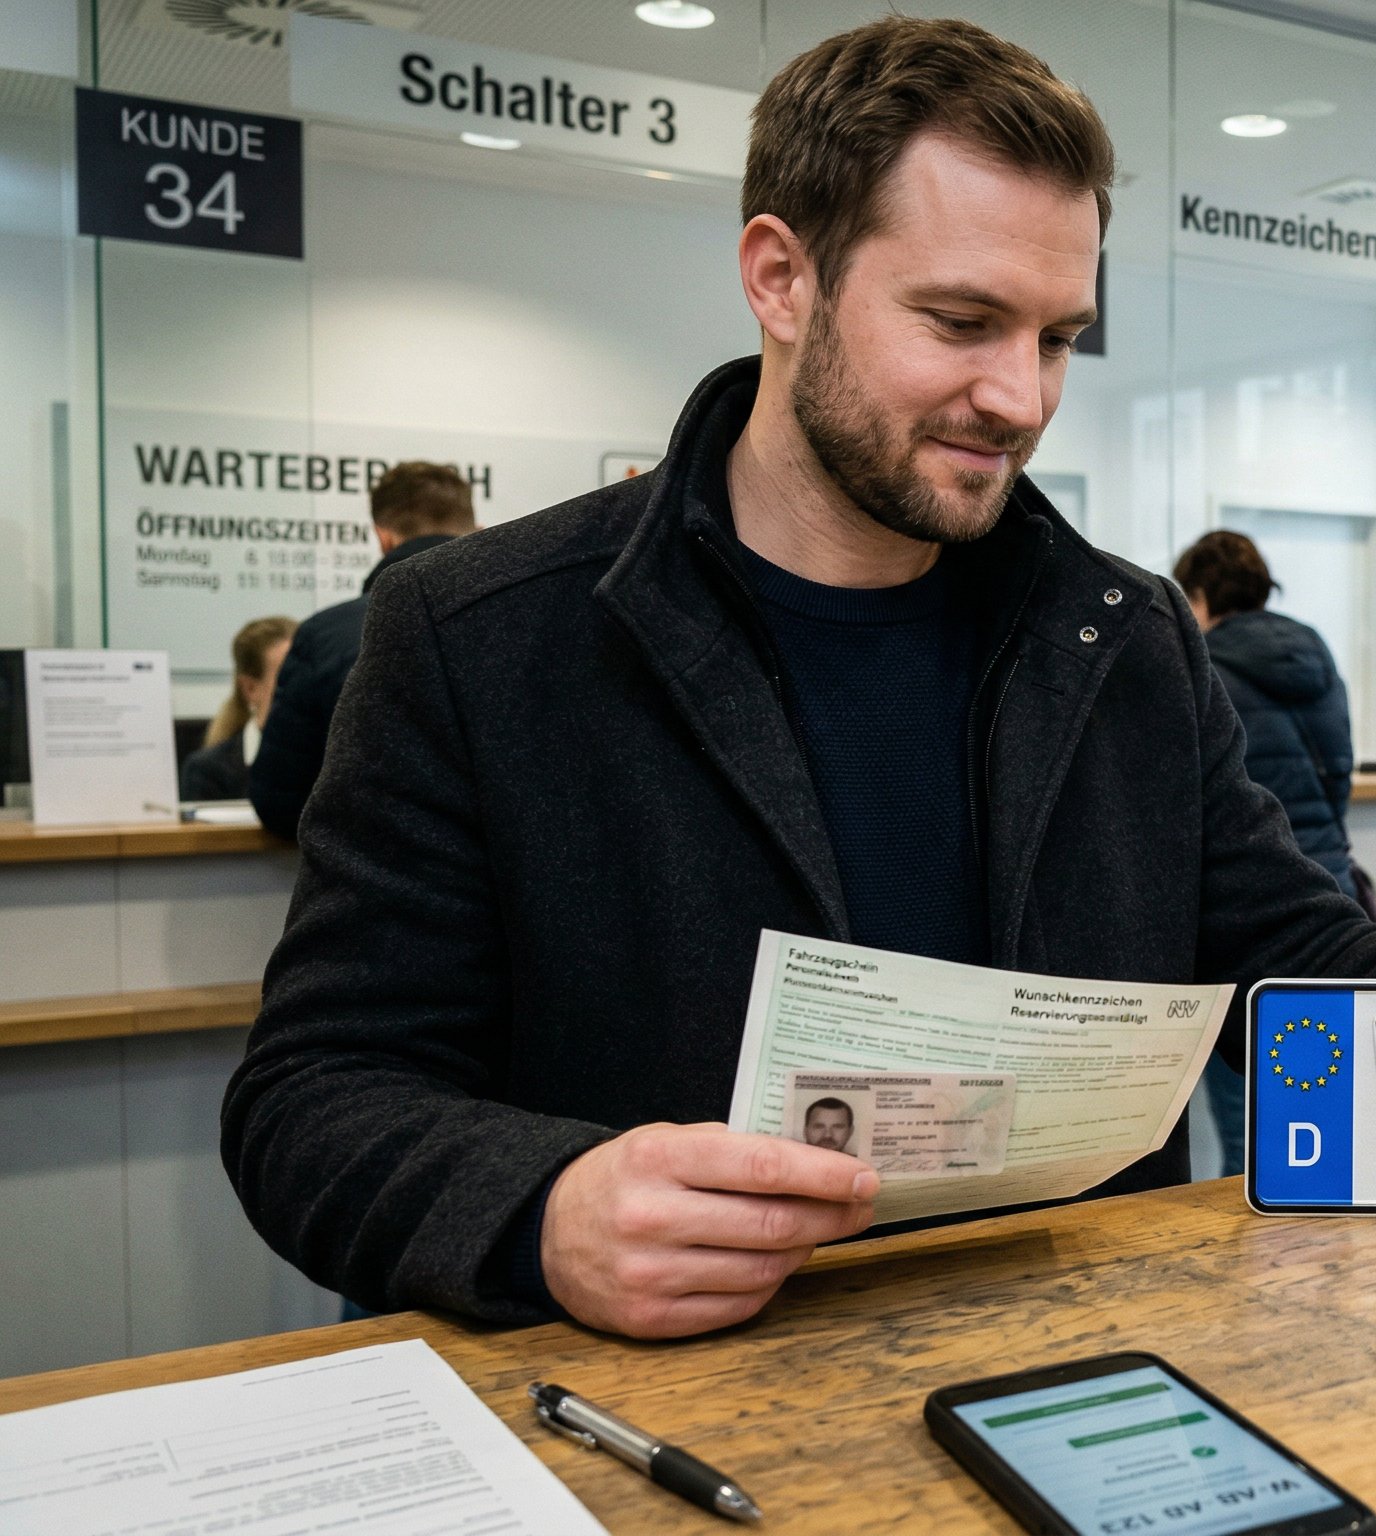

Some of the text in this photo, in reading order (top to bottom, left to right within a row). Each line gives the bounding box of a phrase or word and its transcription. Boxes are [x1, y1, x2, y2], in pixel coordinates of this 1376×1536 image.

[400, 52, 676, 145] Schalter 3
[120, 108, 266, 161] KUNDE
[143, 164, 245, 234] 34
[137, 506, 370, 545] ÖFFNUNGSZEITEN
[1288, 1122, 1322, 1167] D
